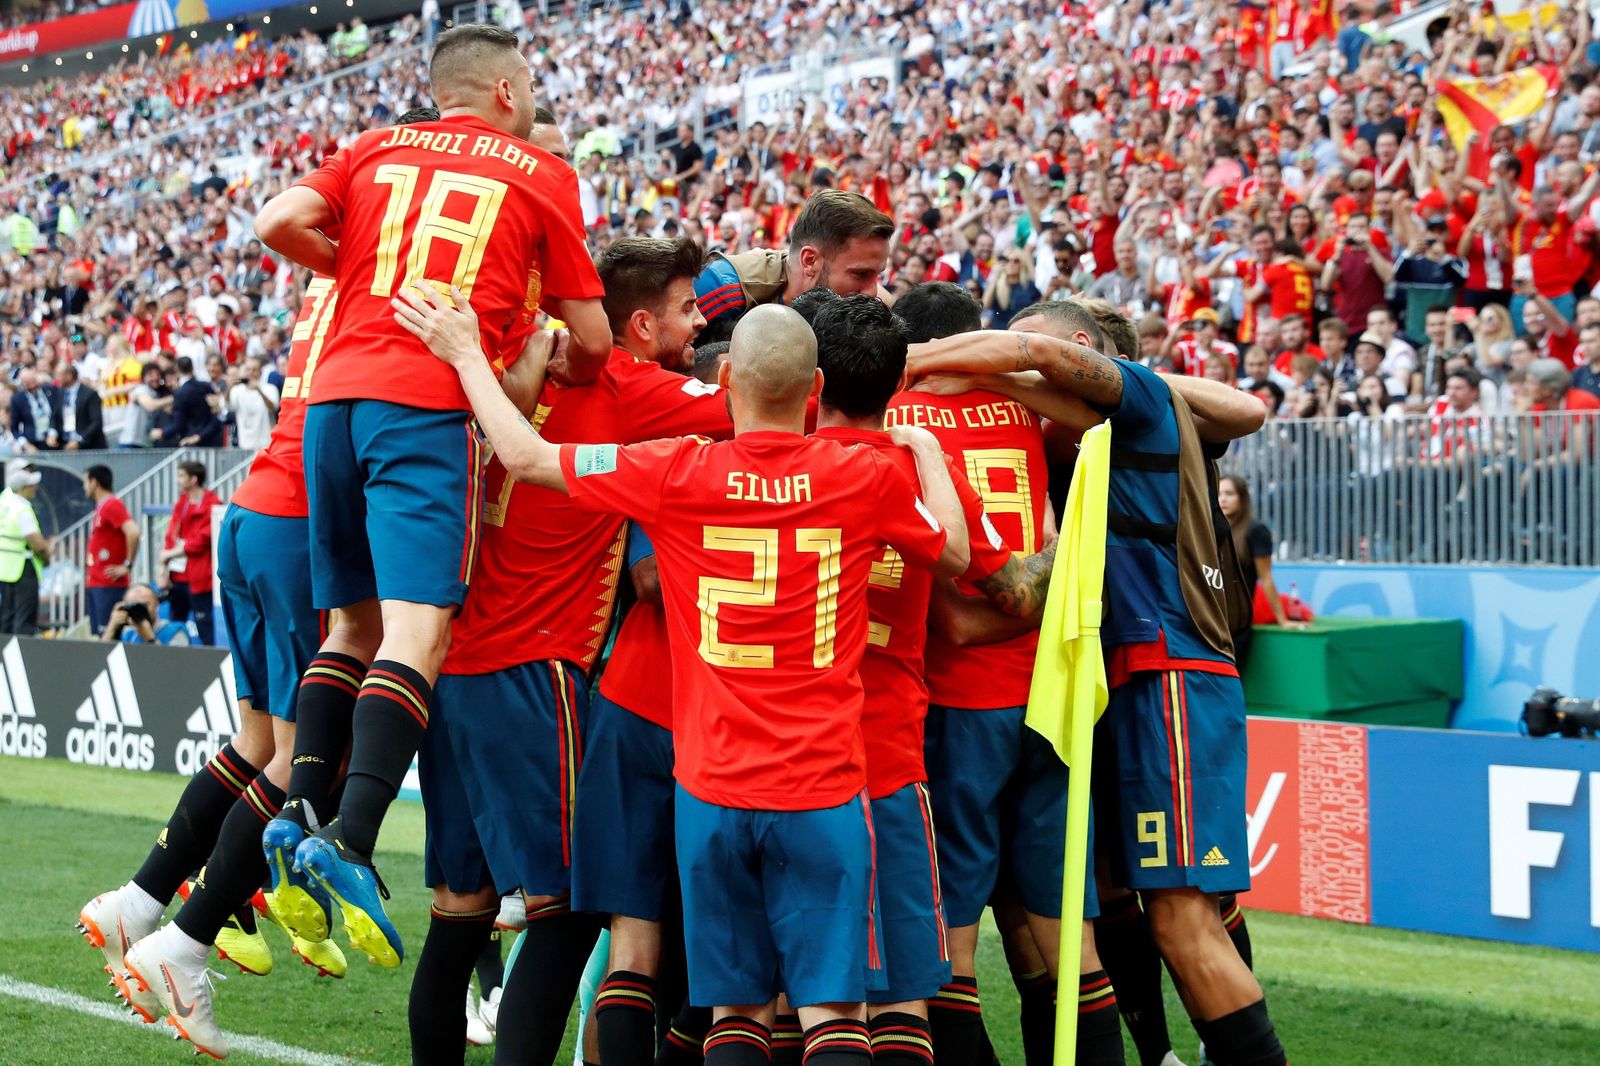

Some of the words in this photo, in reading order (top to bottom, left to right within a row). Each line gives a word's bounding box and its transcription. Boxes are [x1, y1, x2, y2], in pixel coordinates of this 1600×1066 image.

[380, 127, 469, 155] JORDI
[470, 135, 539, 176] ALBA
[369, 164, 509, 307] 18
[883, 405, 957, 432] DIEGO
[962, 401, 1032, 427] COSTA
[726, 471, 812, 503] SILVA
[960, 448, 1036, 560] 9
[697, 525, 842, 669] 21
[66, 718, 155, 772] adidas
[1319, 724, 1343, 805] ВРЕДИТ
[1340, 726, 1367, 835] ЗДОРОВЬЮ
[1137, 811, 1168, 868] 9
[1201, 858, 1231, 867] adidas
[1320, 812, 1344, 920] АЛКОГОЛЯ
[1488, 763, 1600, 929] F
[1342, 839, 1367, 924] ВАШЕМУ
